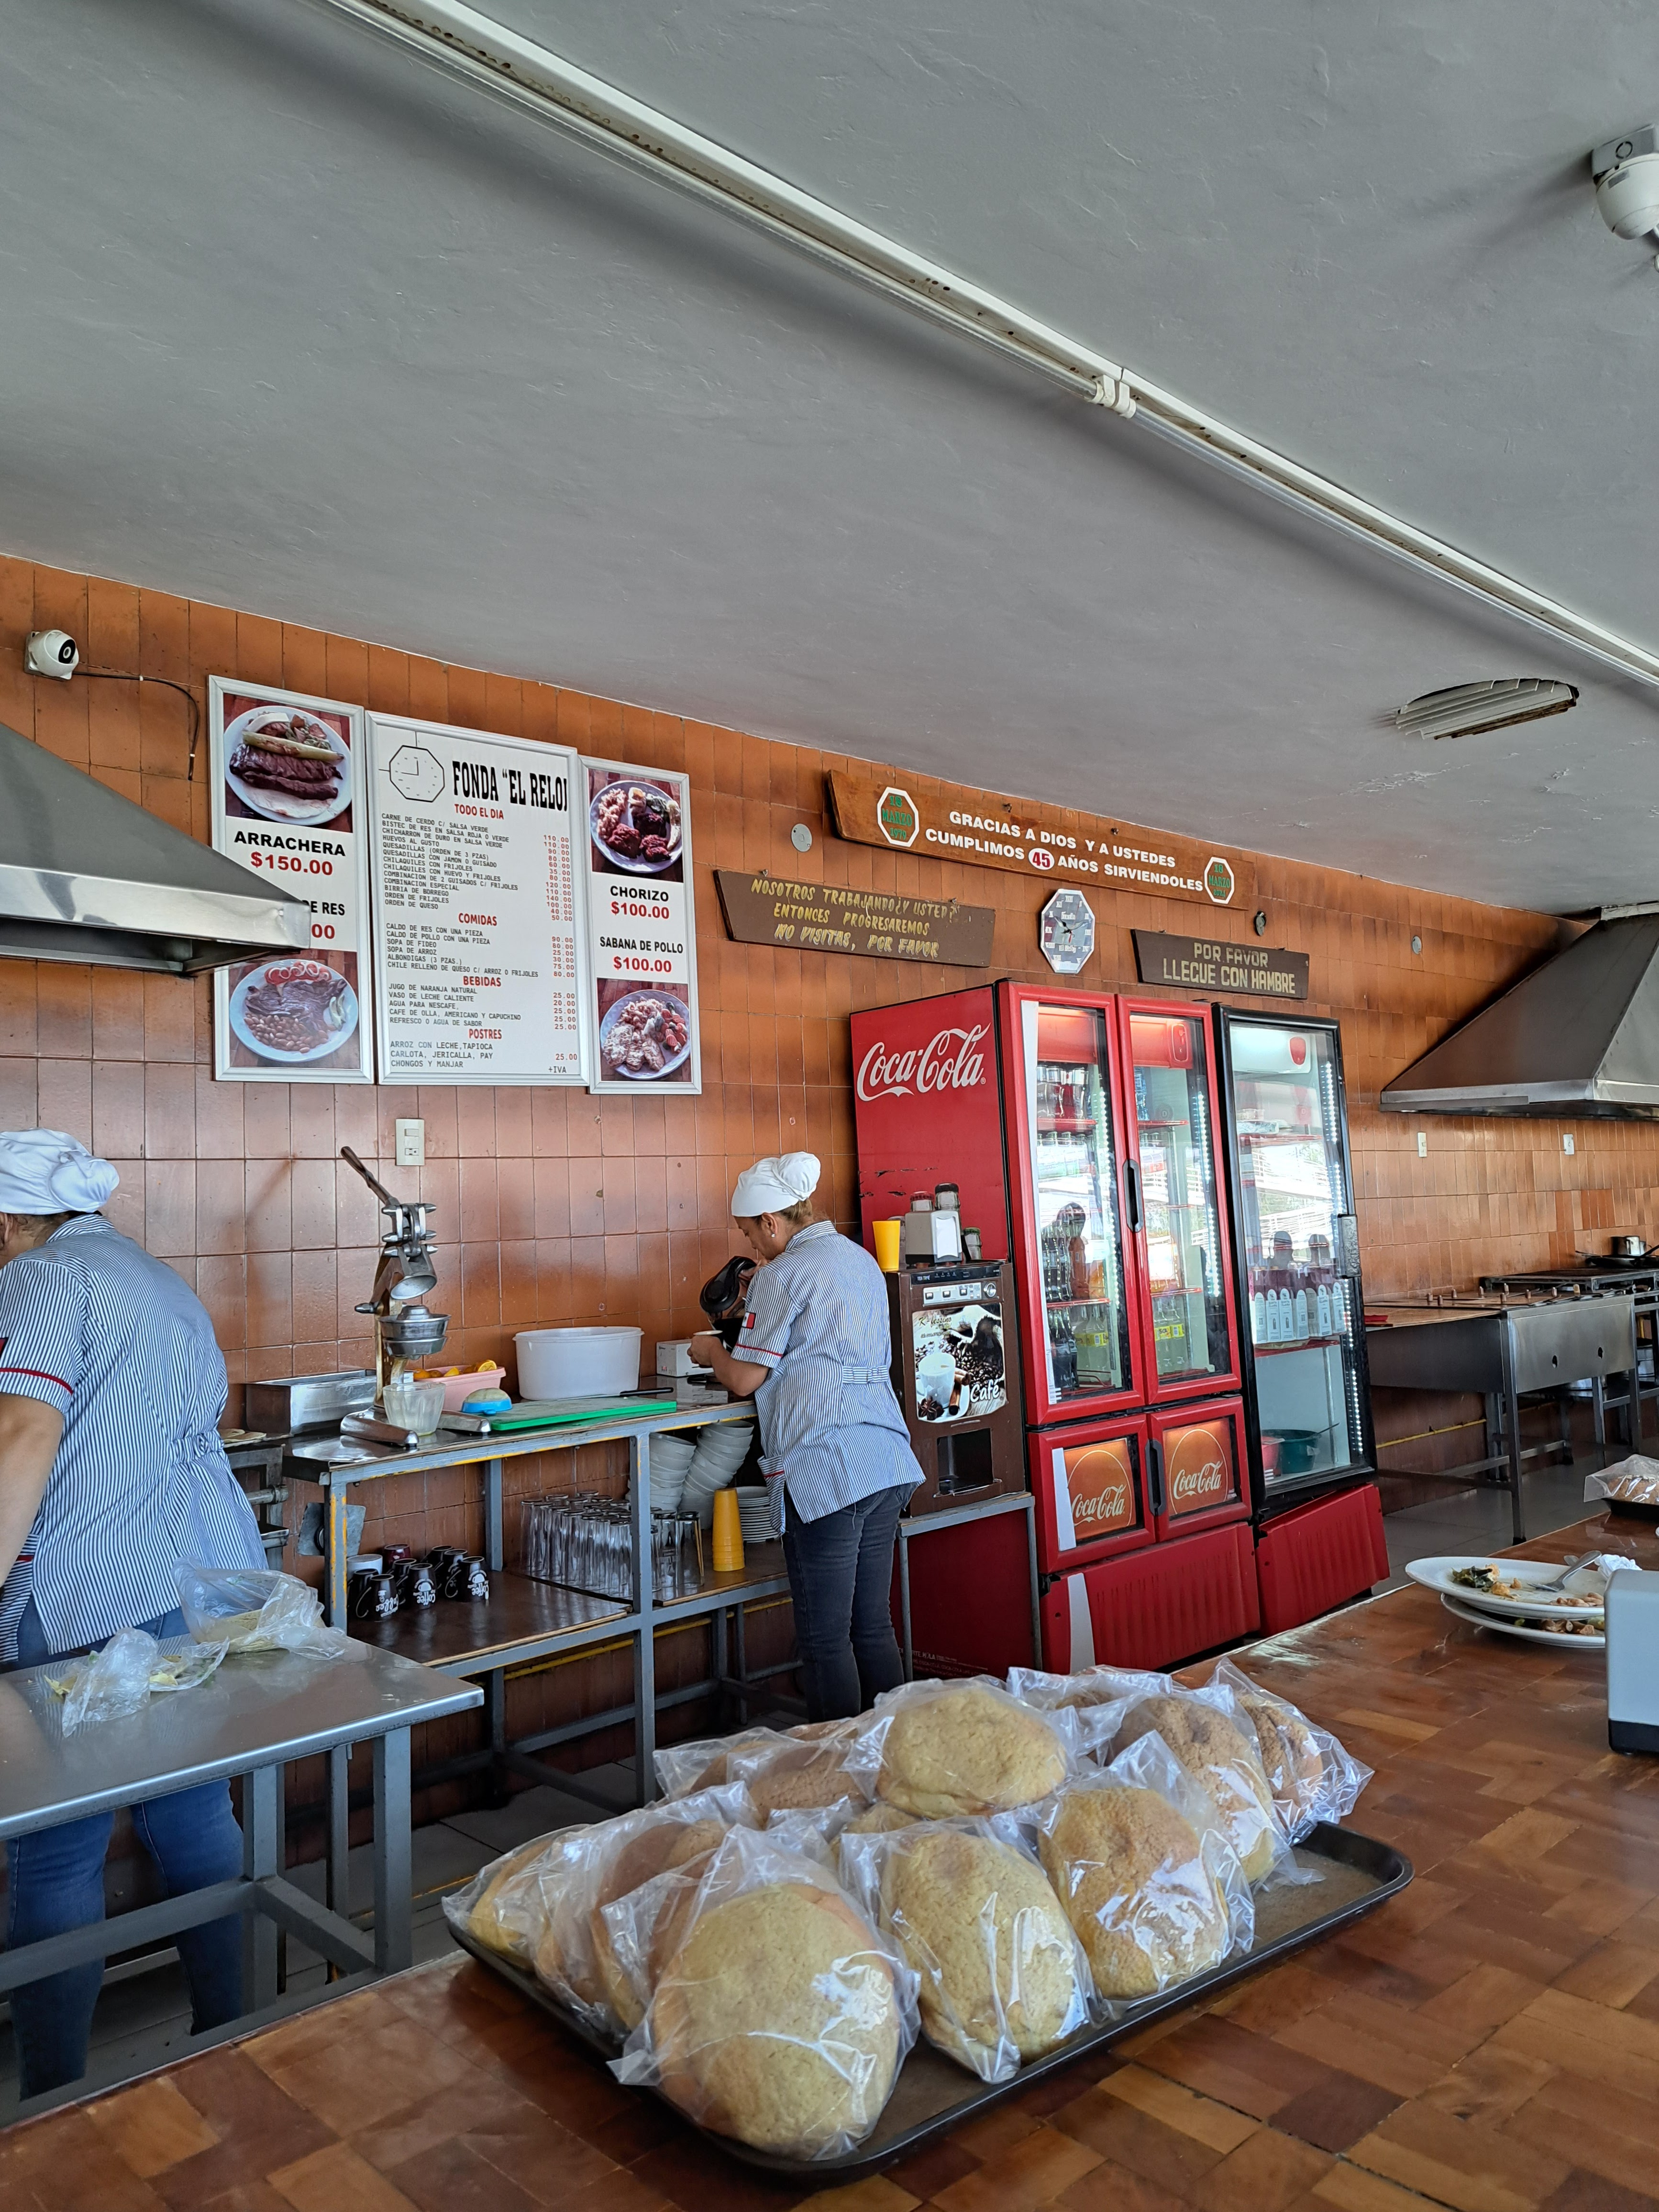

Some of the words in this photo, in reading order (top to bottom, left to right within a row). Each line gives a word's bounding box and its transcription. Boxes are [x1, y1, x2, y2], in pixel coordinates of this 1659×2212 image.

[452, 761, 498, 802] FONDA
[889, 795, 902, 807] 18
[454, 804, 477, 816] TODO
[479, 807, 489, 818] EL
[490, 809, 504, 819] DIA
[881, 808, 913, 827] MARZO
[381, 813, 401, 821] CARNE
[449, 822, 467, 830] SALSA
[543, 834, 569, 842] 110.00
[890, 828, 907, 841] 1979
[234, 830, 345, 857] ARRACHERA
[382, 834, 406, 842] HUEVOS
[383, 841, 425, 852] QUESADILLAS
[949, 810, 1022, 838] GRACIAS
[1025, 828, 1037, 841] A
[1040, 831, 1076, 850] DIOS
[1084, 840, 1095, 852] Y
[1098, 843, 1109, 855] A
[1112, 845, 1176, 868] USTEDES
[250, 851, 334, 876] $150.00
[383, 856, 425, 866] CHILAQUILES
[925, 828, 1025, 860] CUMPLIMOS
[1031, 852, 1051, 867] 45
[1058, 854, 1099, 873] AÑOS
[1104, 863, 1204, 892] SIRVIENDOLES
[1214, 864, 1224, 874] 18
[384, 877, 426, 887] COMBINACION
[430, 882, 459, 891] ESPECIAL
[751, 878, 816, 901] NOSOTROS
[1208, 874, 1230, 888] MARZO
[610, 885, 669, 902] CHORIZO
[322, 902, 345, 916] RES
[611, 902, 670, 919] $100.00
[458, 913, 498, 927] COMIDAS
[774, 903, 830, 923] ENTONCES
[842, 911, 930, 936] PROGRESAREMOS
[600, 936, 637, 950] SABANA
[640, 940, 652, 951] DE
[654, 941, 683, 954] POLLO
[774, 923, 795, 942] NO
[800, 926, 856, 951] VISITAS,
[867, 934, 893, 953] POR
[898, 938, 940, 960] FAVOR
[387, 953, 426, 962] ALBONDIGAS
[1194, 942, 1221, 962] POR
[1226, 947, 1269, 968] FAVOR
[613, 956, 672, 973] $100.00
[463, 975, 501, 987] BEBIDAS
[1163, 958, 1216, 984] LLEGUE
[1221, 965, 1248, 988] CON
[1251, 969, 1295, 994] HAMBRE
[468, 1029, 502, 1040] POSTRES
[856, 1022, 992, 1102] Coca-Cola
[970, 1382, 1000, 1403] Café
[1173, 1460, 1223, 1500] Coca-Cola
[416, 1591, 436, 1606] Coffee
